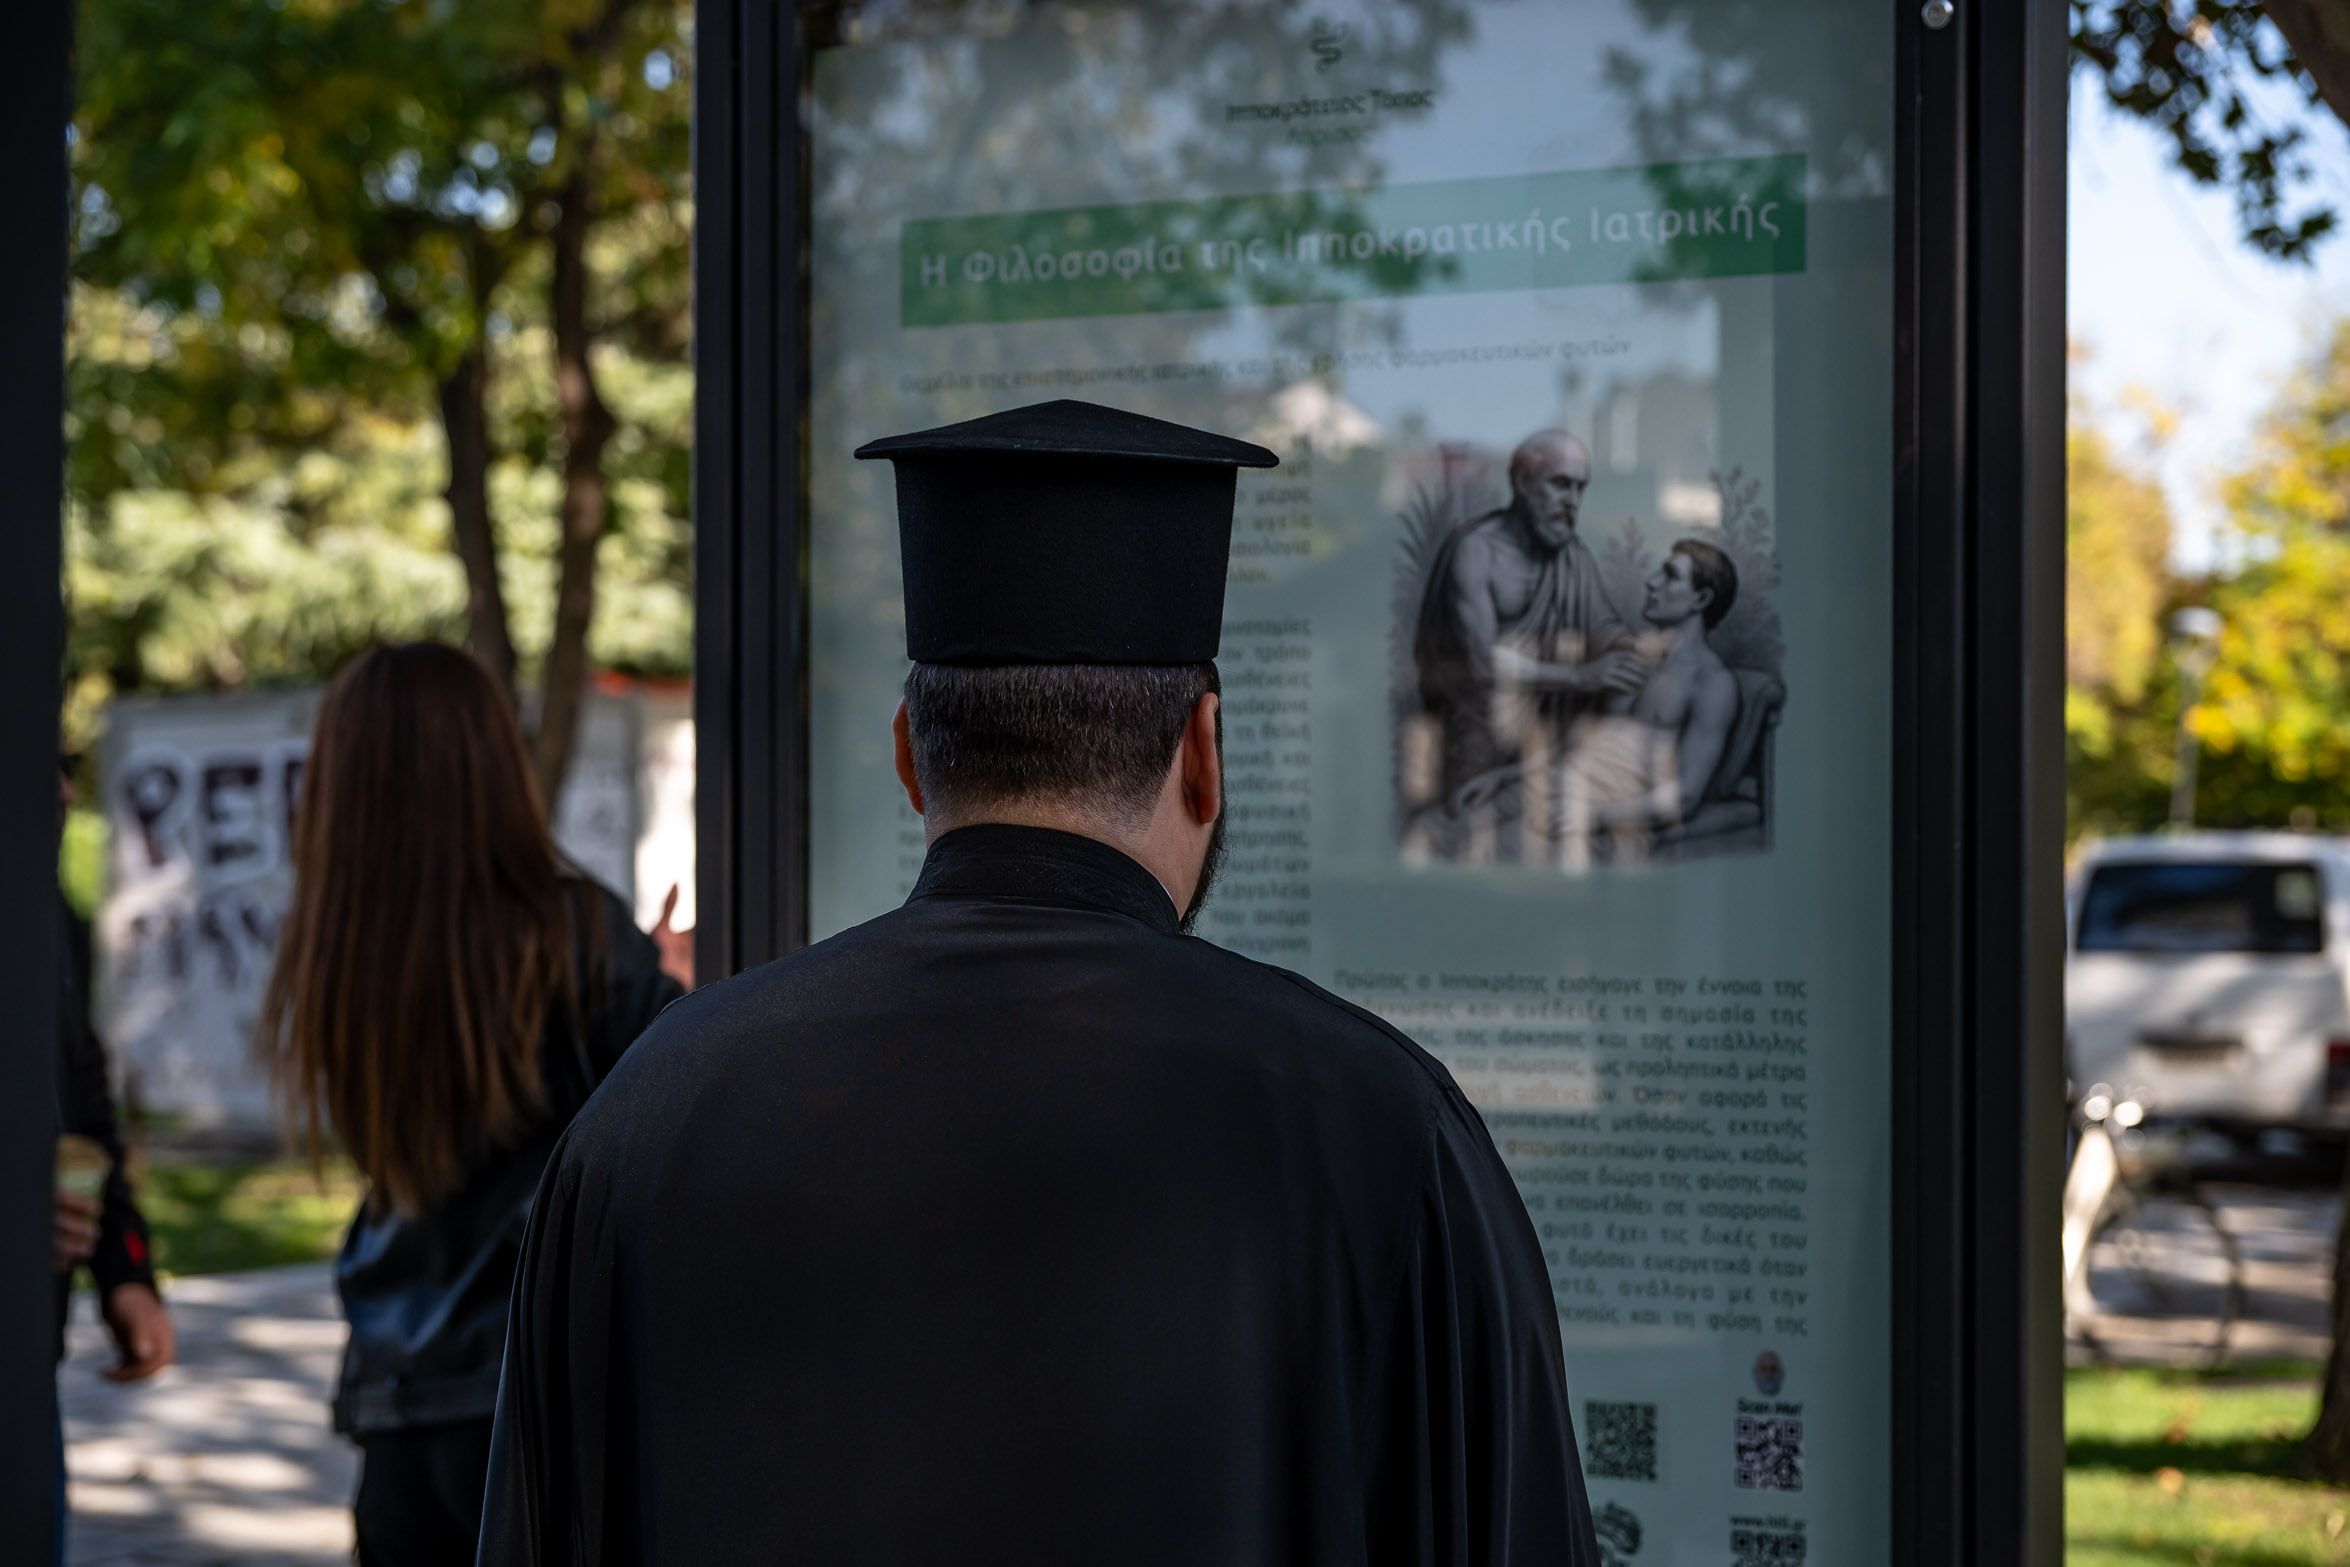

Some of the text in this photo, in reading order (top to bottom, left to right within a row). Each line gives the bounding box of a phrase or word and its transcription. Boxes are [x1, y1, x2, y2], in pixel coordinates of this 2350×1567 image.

[920, 193, 1782, 288] Η Φιλοσοφία της Ιπποκρατικής Ιατρικής
[1389, 339, 1554, 369] φαρμακευτικών
[1559, 333, 1632, 360] φυτών
[1334, 968, 1807, 1000] Πρώτος ο Ιπποκράτης εισήγαγε την έννοια της
[1466, 1000, 1501, 1017] και
[1623, 1004, 1647, 1024] τη
[1660, 1002, 1755, 1025] σημασία
[1770, 1007, 1807, 1029] της
[1454, 1028, 1488, 1047] της
[1498, 1026, 1585, 1049] άσκησης
[1597, 1032, 1627, 1050] και
[1640, 1032, 1674, 1053] της
[1686, 1029, 1807, 1056] κατάλληλης
[1625, 1055, 1739, 1081] προληπτικά
[1745, 1058, 1806, 1082] μέτρα
[1697, 1087, 1768, 1110] αφορά
[1780, 1092, 1807, 1113] τις
[1612, 1110, 1716, 1137] μεθόδους,
[1728, 1116, 1807, 1140] εκτενής
[1662, 1141, 1736, 1165] φυτών,
[1740, 1142, 1807, 1167] καθώς
[1516, 1163, 1807, 1195] ωρούσε δώρα της φύσης που
[1555, 1192, 1653, 1214] επανέλθει
[1662, 1199, 1686, 1217] σε
[1696, 1198, 1806, 1221] ισορροπία.
[1604, 1221, 1648, 1245] έχει
[1660, 1227, 1689, 1247] τις
[1699, 1222, 1757, 1250] δικές
[1770, 1232, 1807, 1250] του
[1568, 1246, 1635, 1270] δράσει
[1642, 1251, 1751, 1276] ευεργετικά
[1759, 1256, 1807, 1277] όταν
[1558, 1273, 1807, 1308] στά, ανάλογα με την
[1630, 1309, 1661, 1326] και
[1672, 1309, 1695, 1329] τη
[1705, 1309, 1762, 1333] φύση
[1775, 1315, 1807, 1336] της
